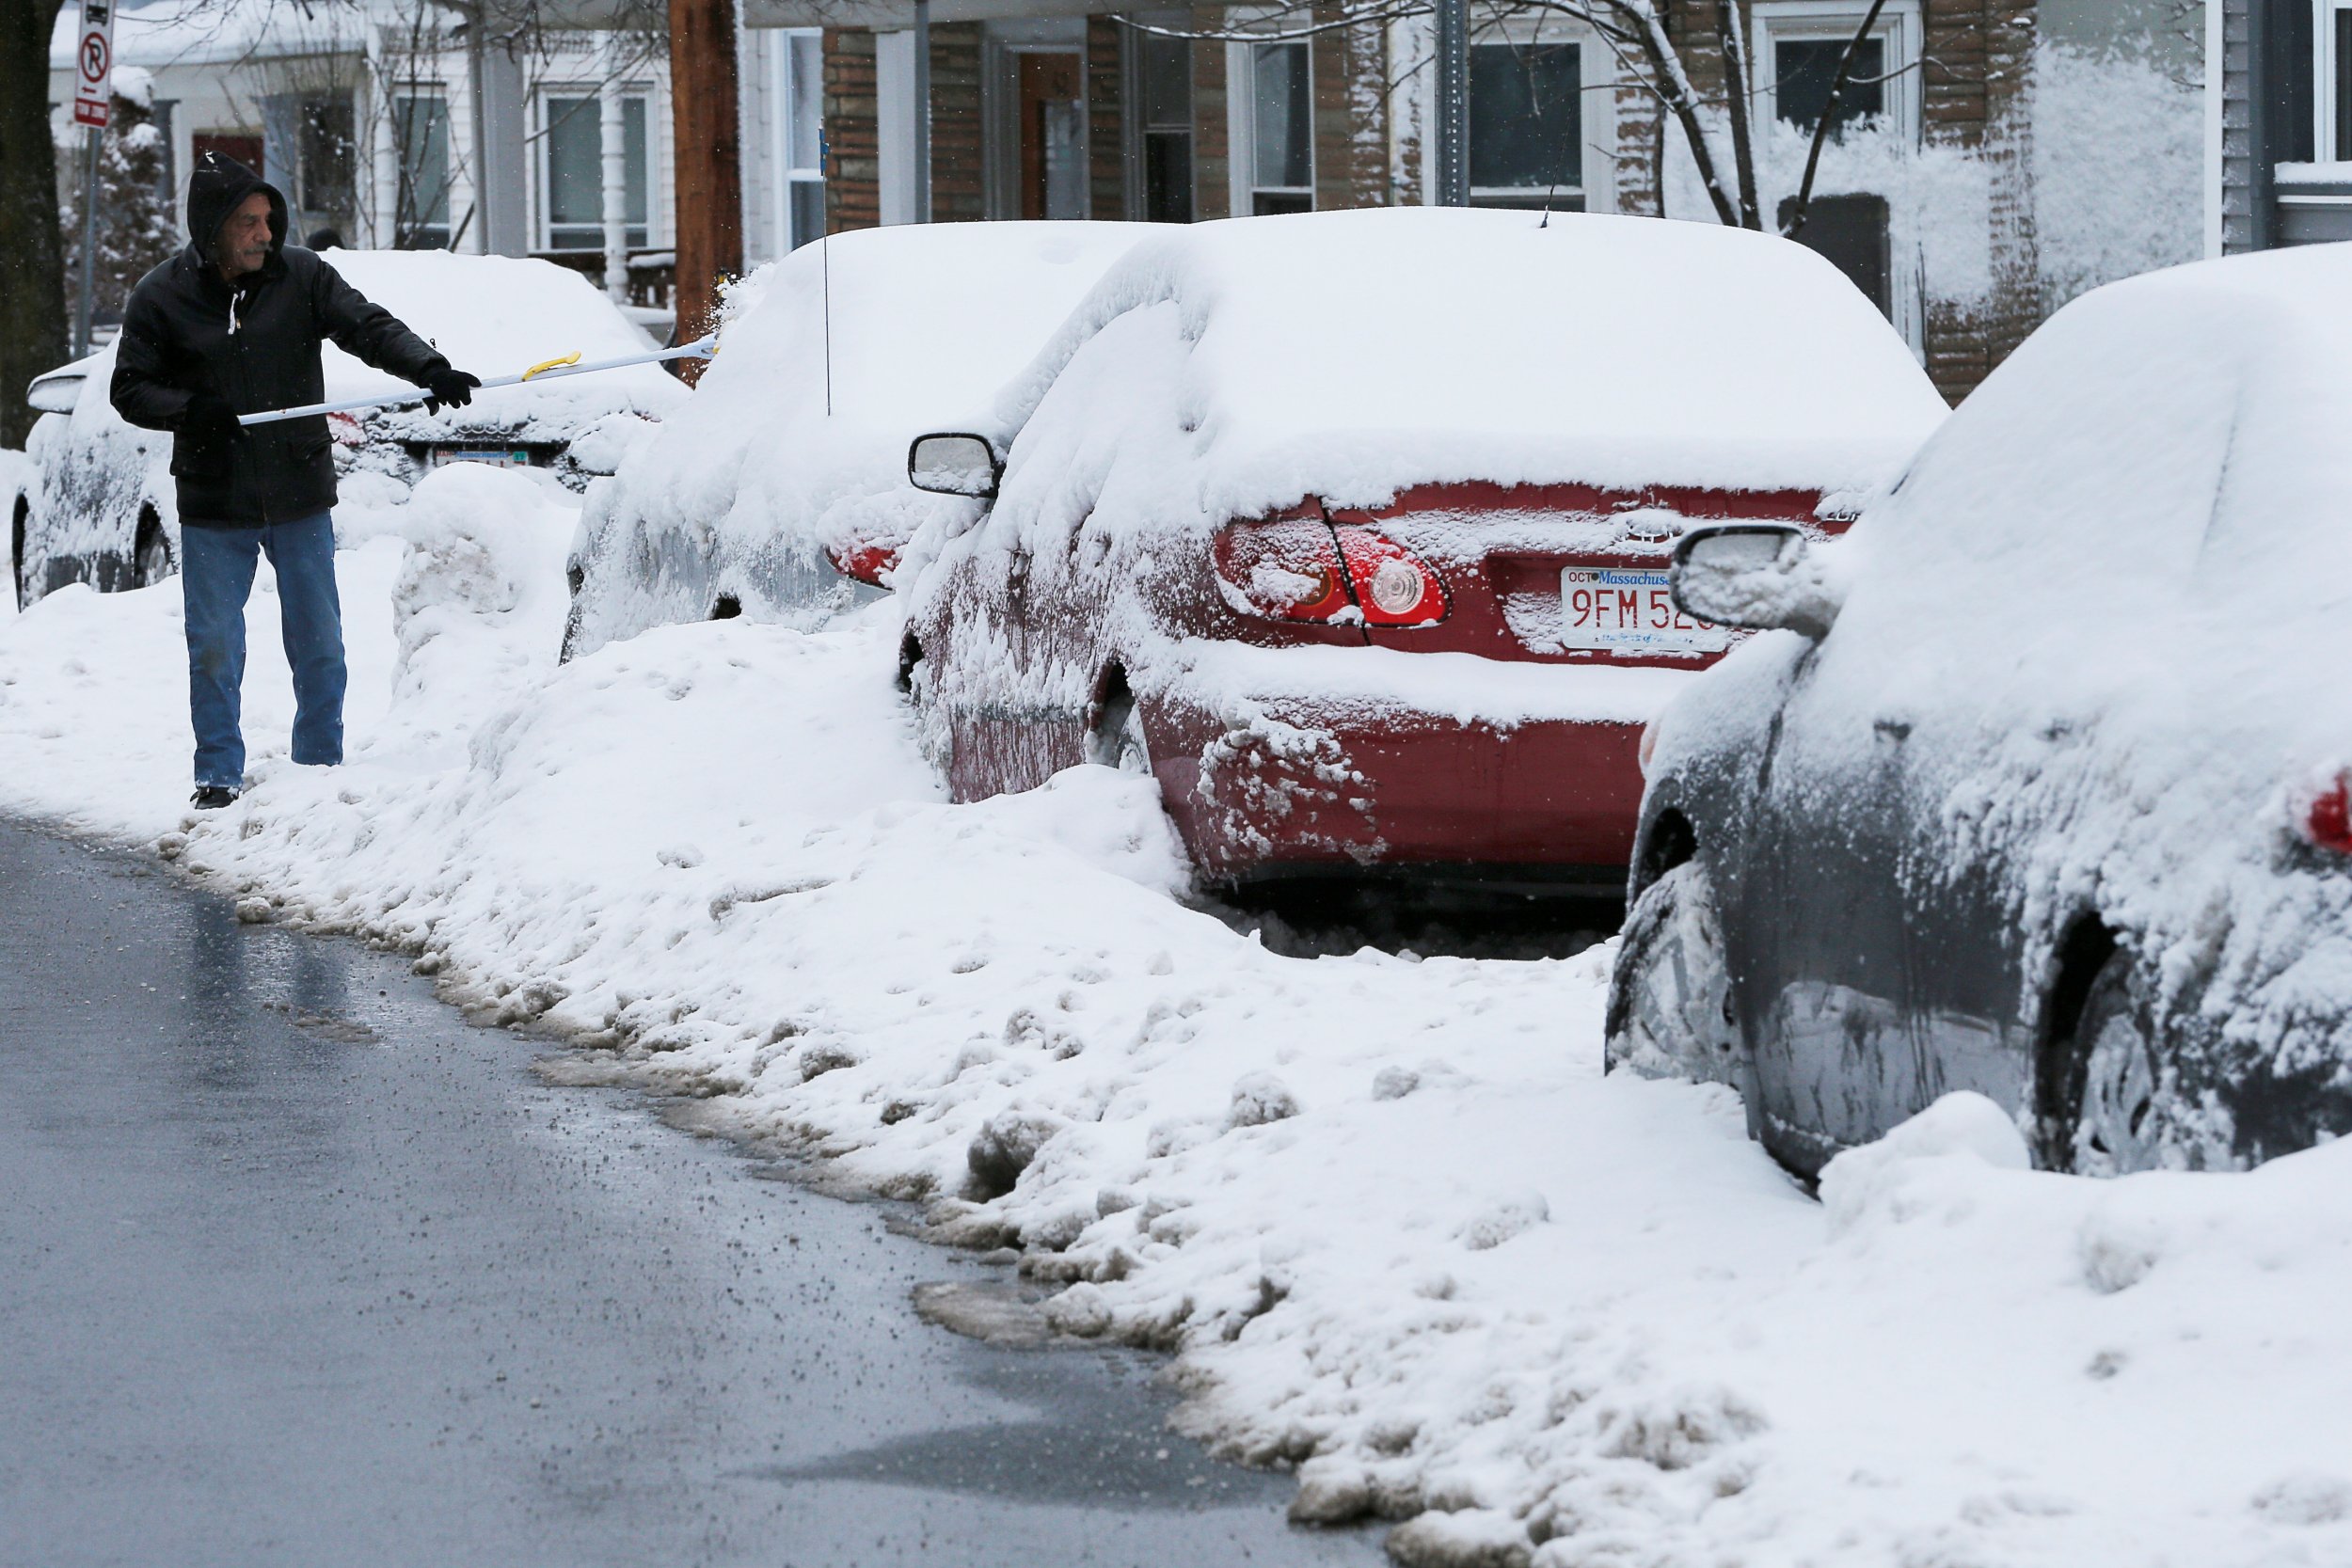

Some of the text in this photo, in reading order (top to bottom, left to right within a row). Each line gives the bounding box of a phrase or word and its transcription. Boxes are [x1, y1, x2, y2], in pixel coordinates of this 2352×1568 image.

[1568, 571, 1670, 585] OCT Massachus
[1572, 590, 1717, 629] 9FM 52
